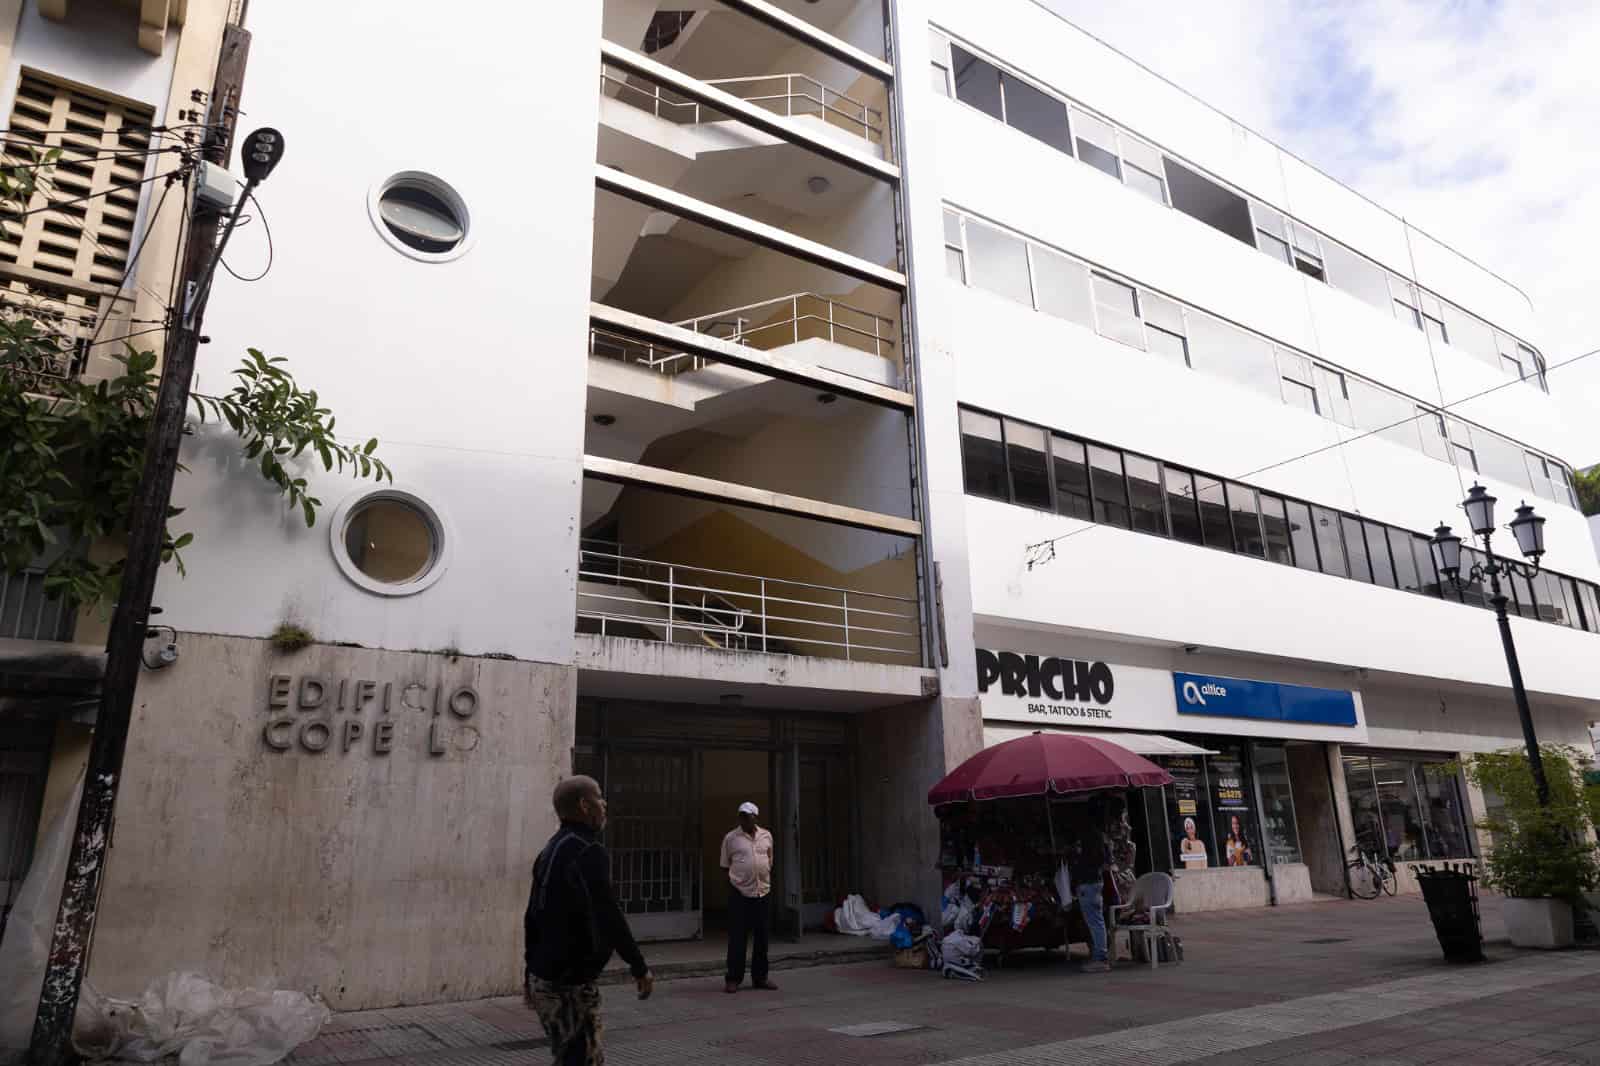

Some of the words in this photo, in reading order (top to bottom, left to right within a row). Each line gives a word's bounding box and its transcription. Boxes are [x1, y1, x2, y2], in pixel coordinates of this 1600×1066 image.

[975, 647, 1114, 705] PRICHO
[269, 675, 479, 720] EDIFICIO
[1201, 684, 1227, 698] altice
[1028, 703, 1047, 716] BAR,
[1048, 705, 1079, 717] TATTOO
[1080, 708, 1086, 717] &
